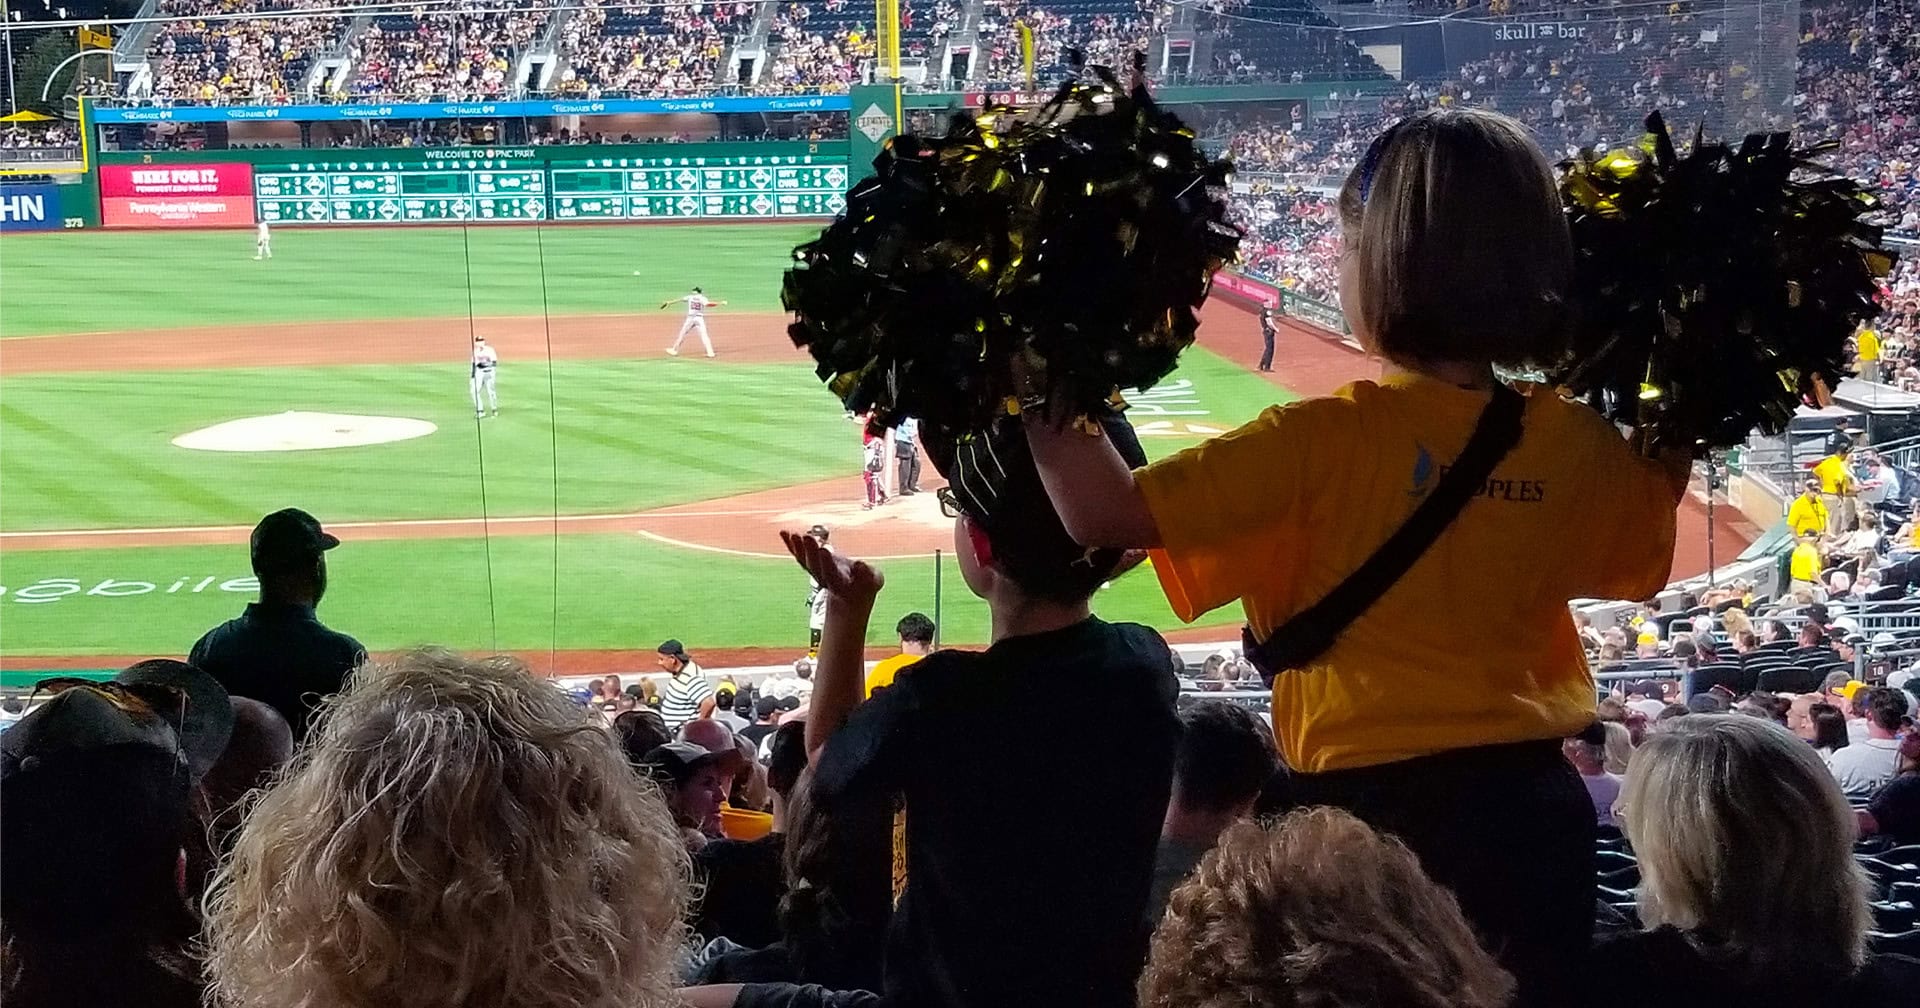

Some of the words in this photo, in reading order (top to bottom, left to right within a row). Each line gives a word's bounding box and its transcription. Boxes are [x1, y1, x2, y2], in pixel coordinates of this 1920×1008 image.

[1495, 23, 1535, 40] skull
[1558, 22, 1586, 39] bar
[425, 150, 470, 159] WELCOME
[472, 150, 485, 158] TO
[495, 149, 513, 158] PNC
[514, 149, 536, 158] PARK
[171, 169, 199, 184] FOR
[1661, 683, 1669, 693] 9
